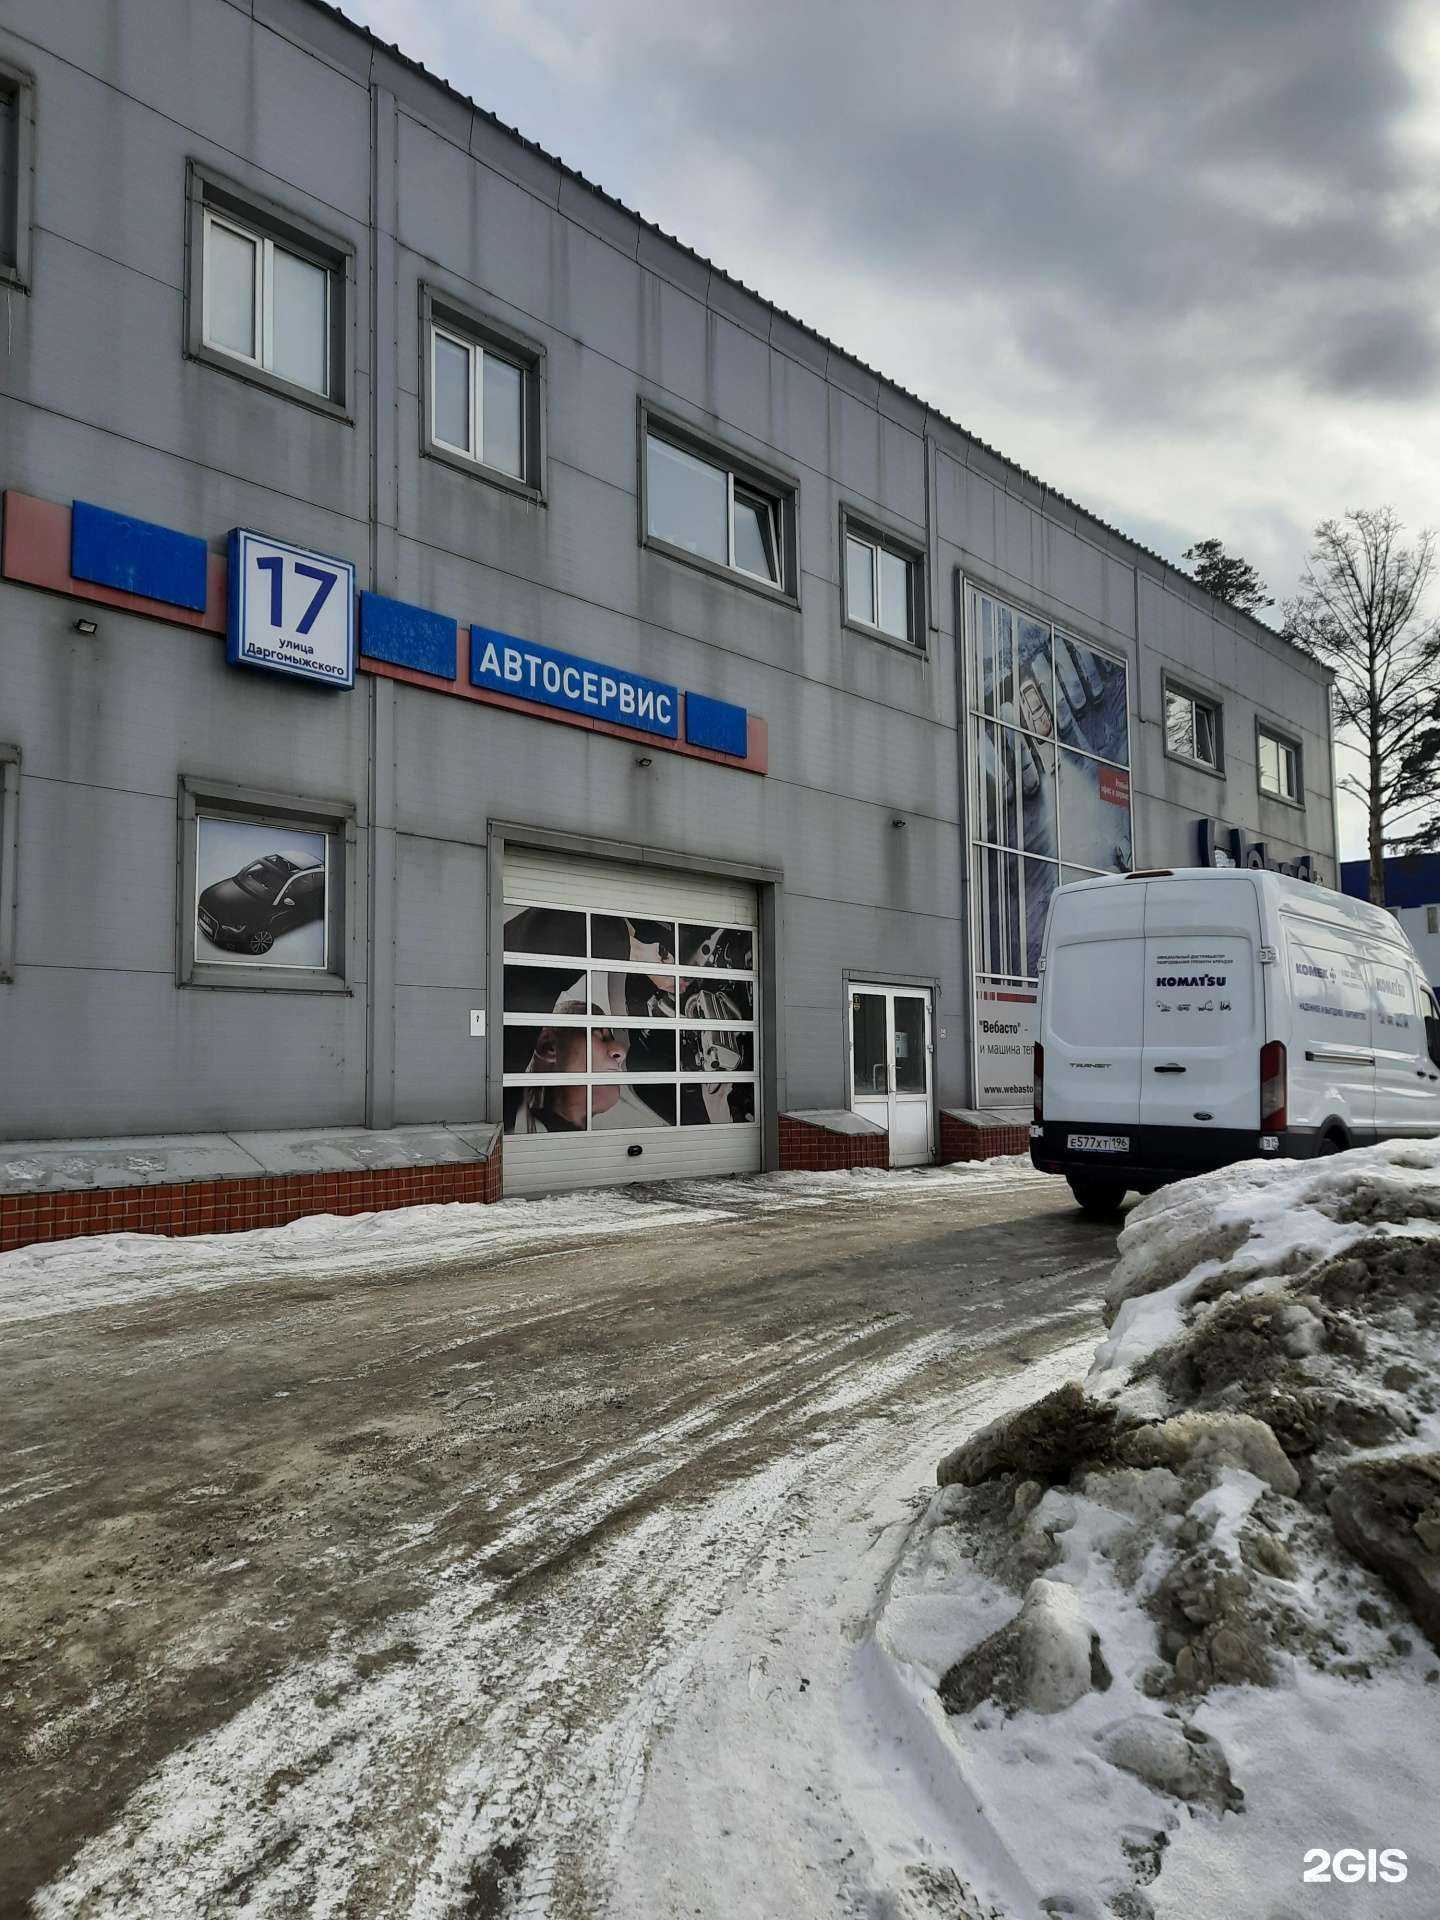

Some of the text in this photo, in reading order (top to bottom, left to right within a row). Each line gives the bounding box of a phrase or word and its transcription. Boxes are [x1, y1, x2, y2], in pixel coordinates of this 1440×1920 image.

[256, 556, 338, 635] 17
[278, 638, 314, 655] улица
[246, 642, 344, 676] Даргомыжского
[479, 642, 672, 724] АВТОСЕРВИС
[1156, 973, 1227, 987] KOMATSU
[979, 1020, 1021, 1034] "Вебасто"
[980, 1045, 985, 1055] и
[987, 1044, 1021, 1056] машина
[983, 1084, 1034, 1094] www.webasto
